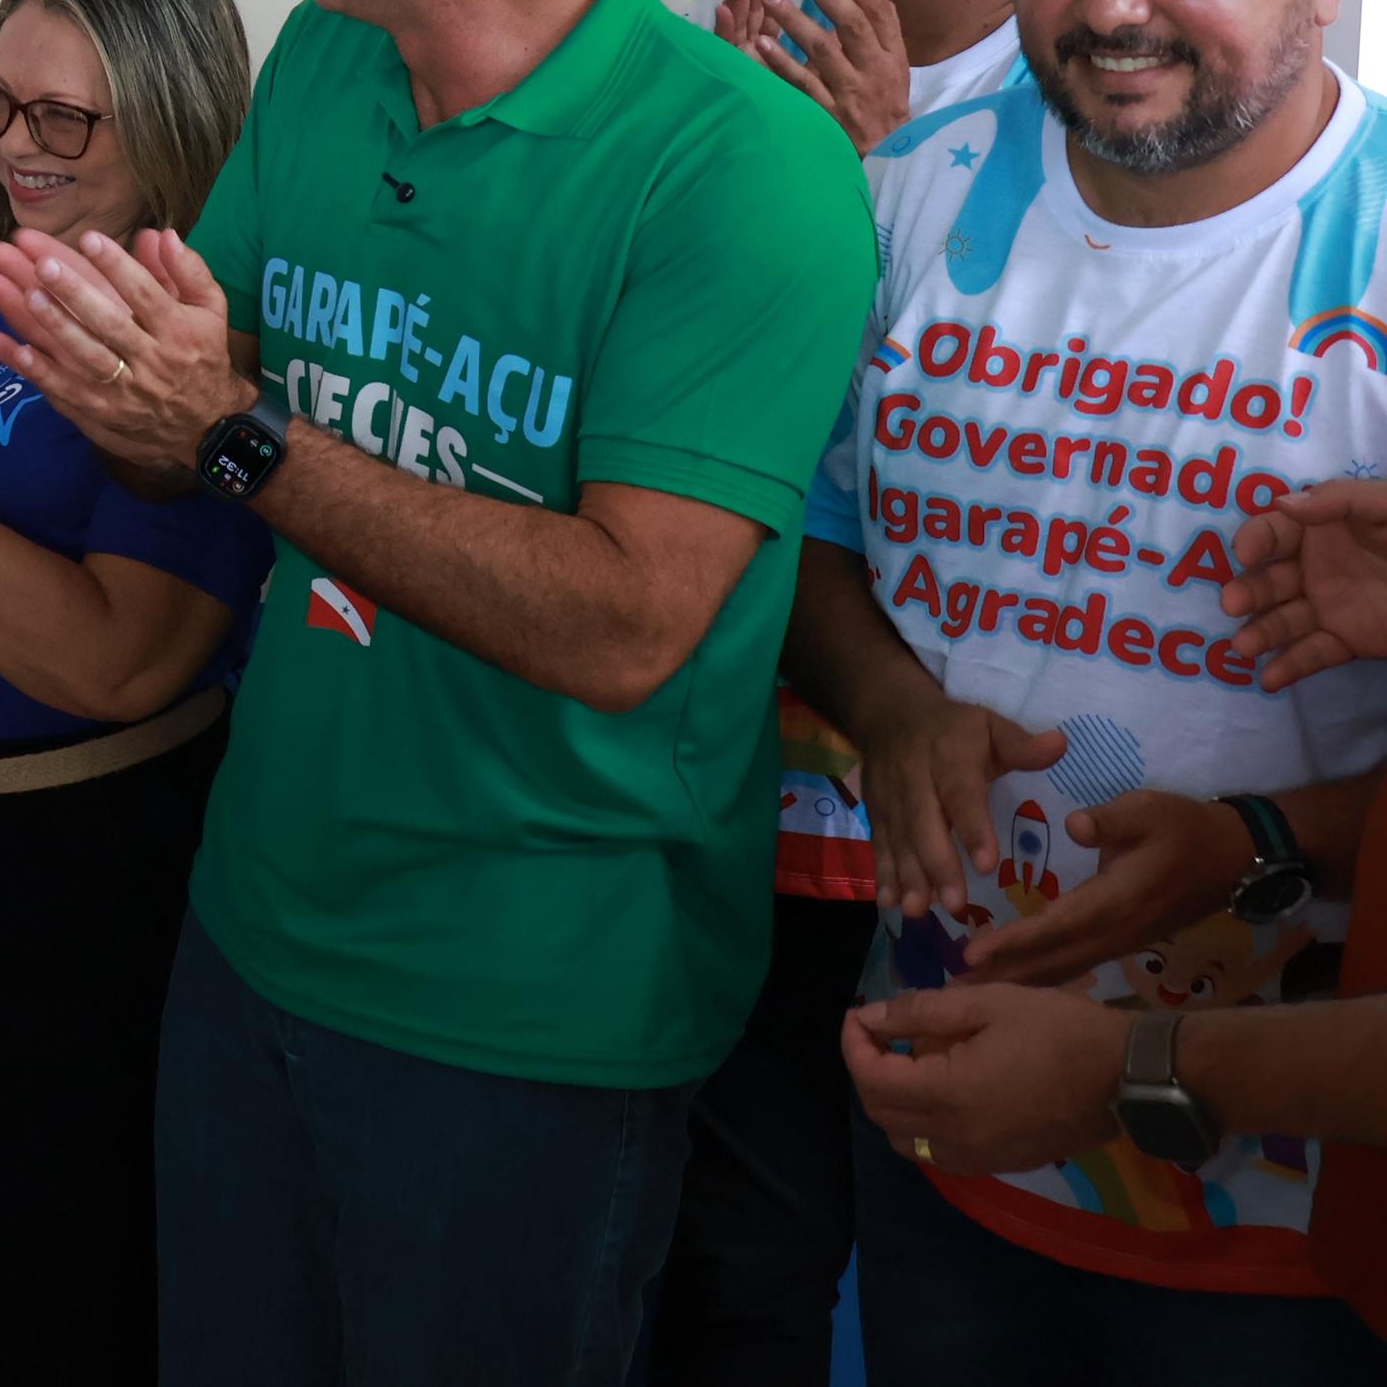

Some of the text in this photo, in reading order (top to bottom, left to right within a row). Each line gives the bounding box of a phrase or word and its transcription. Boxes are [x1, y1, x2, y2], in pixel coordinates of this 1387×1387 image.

[261, 257, 573, 448] GARAPÉ-AÇU
[918, 322, 1312, 437] Obrigado!
[218, 455, 248, 482] 11:32
[874, 393, 1312, 517] Governado
[868, 466, 1234, 587] Igarapé-A
[892, 554, 1256, 687] Agradece
